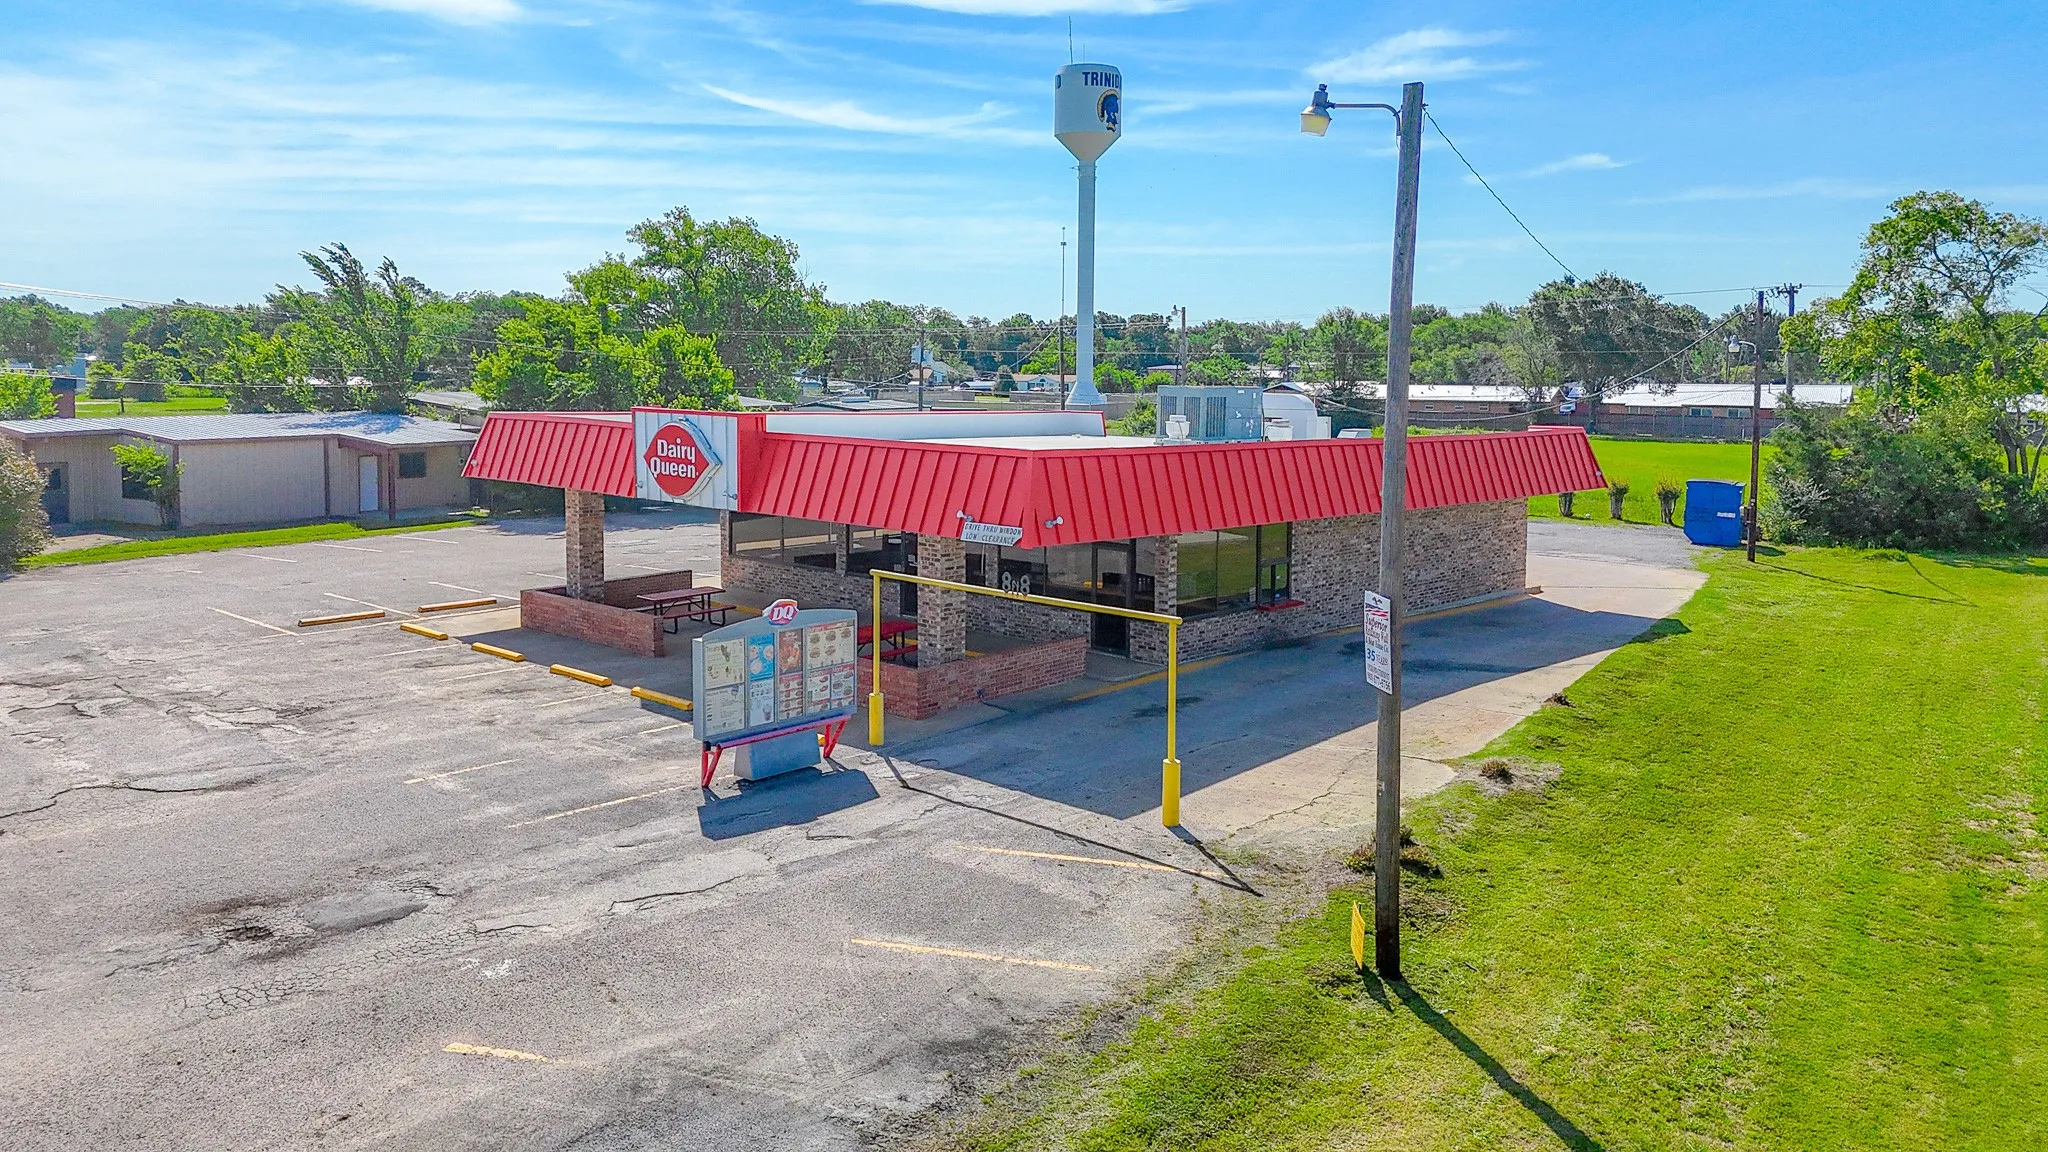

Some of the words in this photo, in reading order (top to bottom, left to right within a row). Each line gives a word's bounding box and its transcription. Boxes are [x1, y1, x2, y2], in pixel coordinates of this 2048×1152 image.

[657, 437, 696, 463] Dairy
[650, 456, 696, 478] Queen
[965, 522, 981, 531] DRIVE
[983, 525, 998, 533] THRU
[999, 527, 1022, 536] WINDOW
[965, 532, 978, 540] LOW
[981, 534, 1015, 545] CLEARANCE
[772, 605, 794, 620] DQ
[1365, 612, 1388, 632] Superior
[1366, 648, 1376, 661] 35
